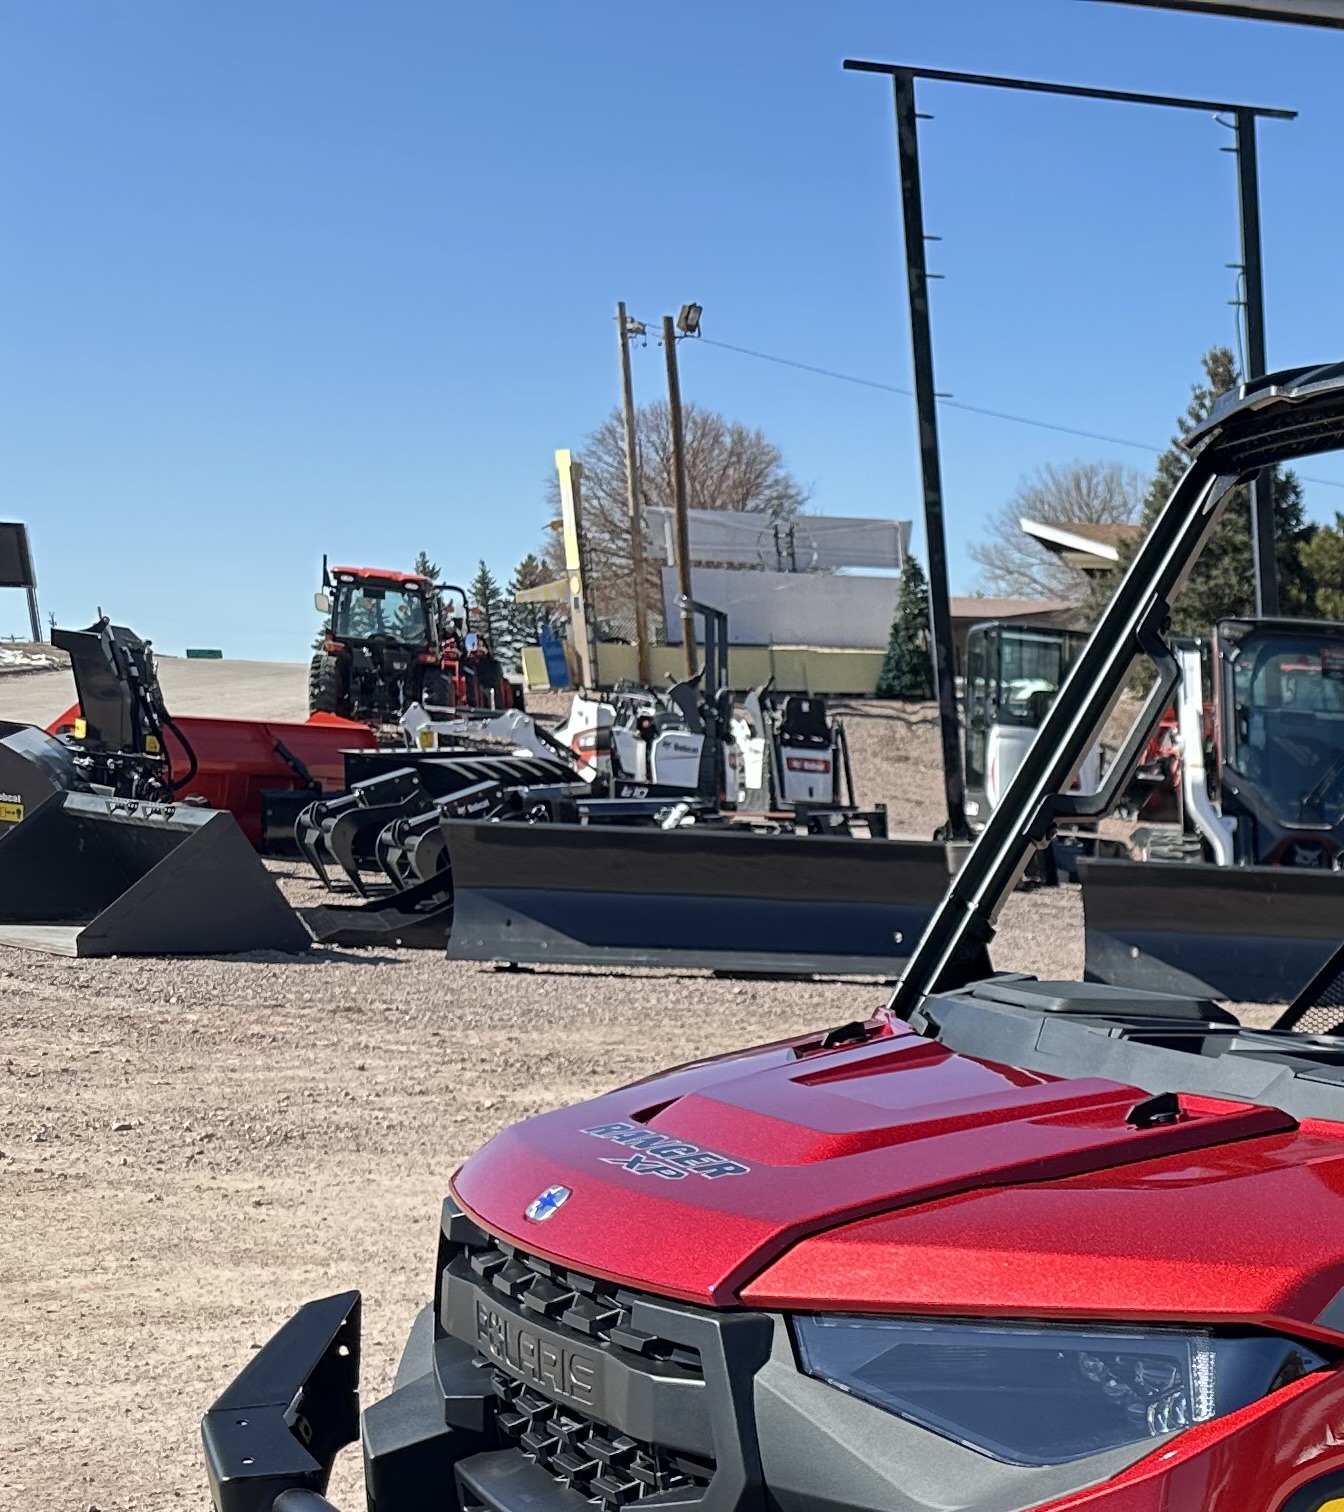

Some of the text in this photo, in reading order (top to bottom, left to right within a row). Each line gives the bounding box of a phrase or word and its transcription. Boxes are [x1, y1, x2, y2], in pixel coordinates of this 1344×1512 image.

[578, 1122, 751, 1180] RANGER
[597, 1153, 690, 1180] XP
[476, 1298, 596, 1406] POLARIS
